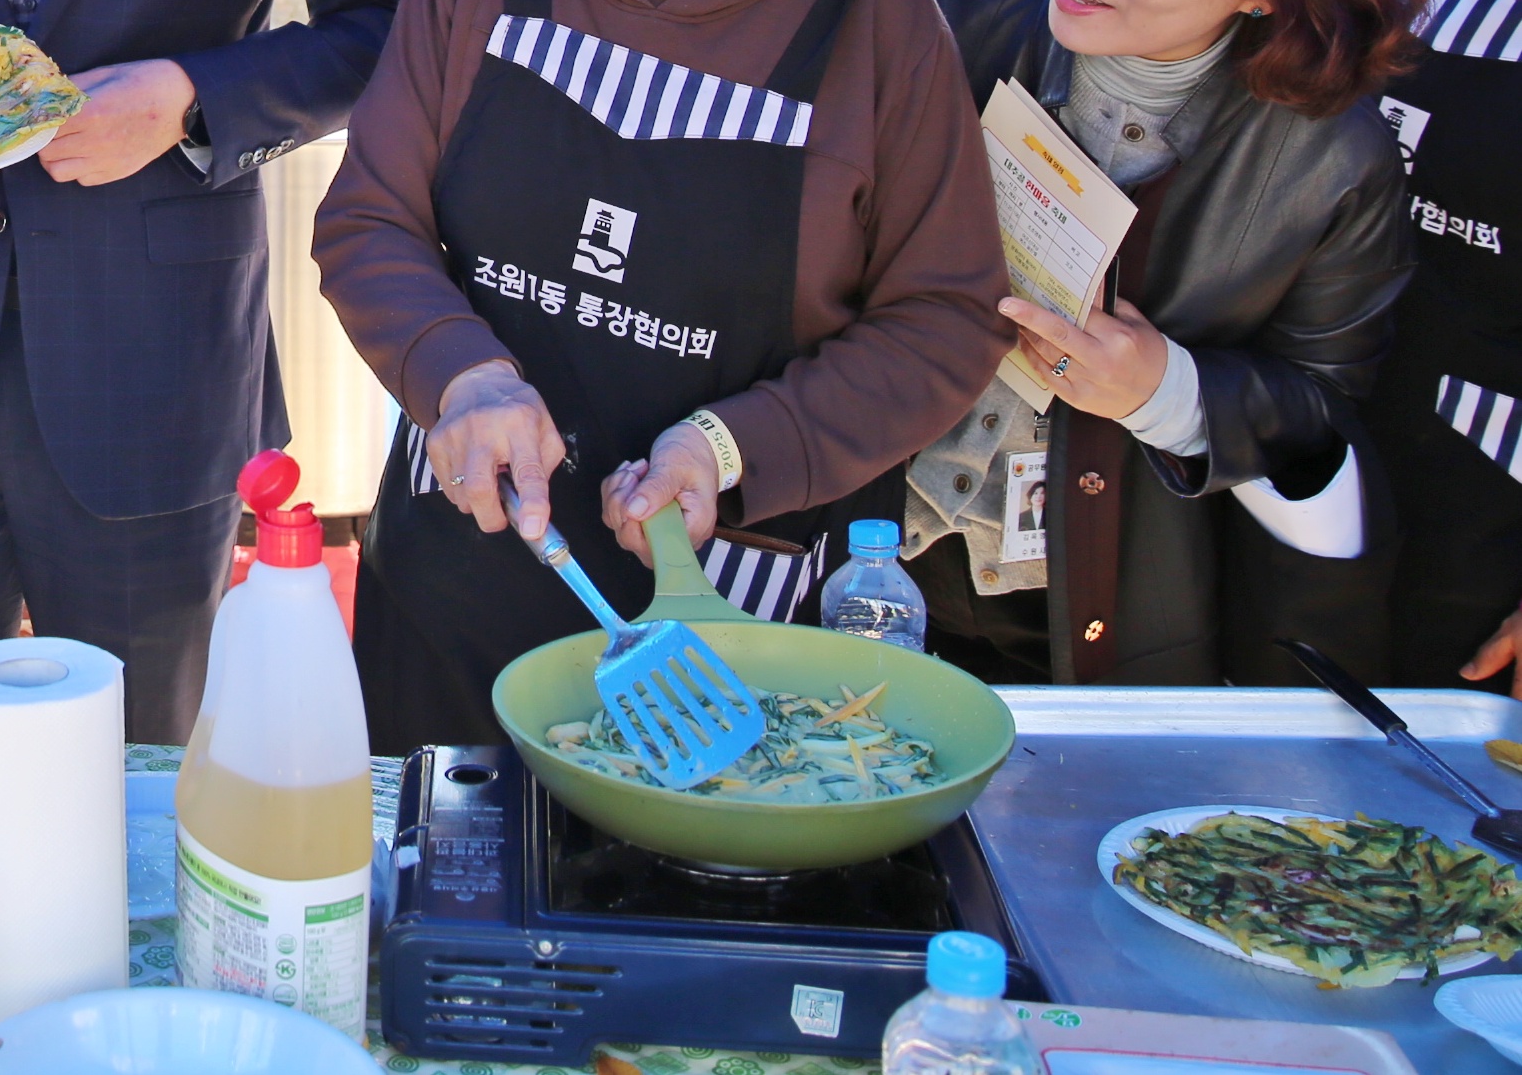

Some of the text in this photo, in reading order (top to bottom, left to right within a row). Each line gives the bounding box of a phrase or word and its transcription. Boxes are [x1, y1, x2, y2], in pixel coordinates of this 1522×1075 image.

[1003, 157, 1026, 184] 대추골
[1024, 179, 1051, 208] 한마음
[1050, 204, 1067, 224] 축제
[475, 256, 717, 359] 조원1동 통장협의회
[712, 431, 734, 471] 2025
